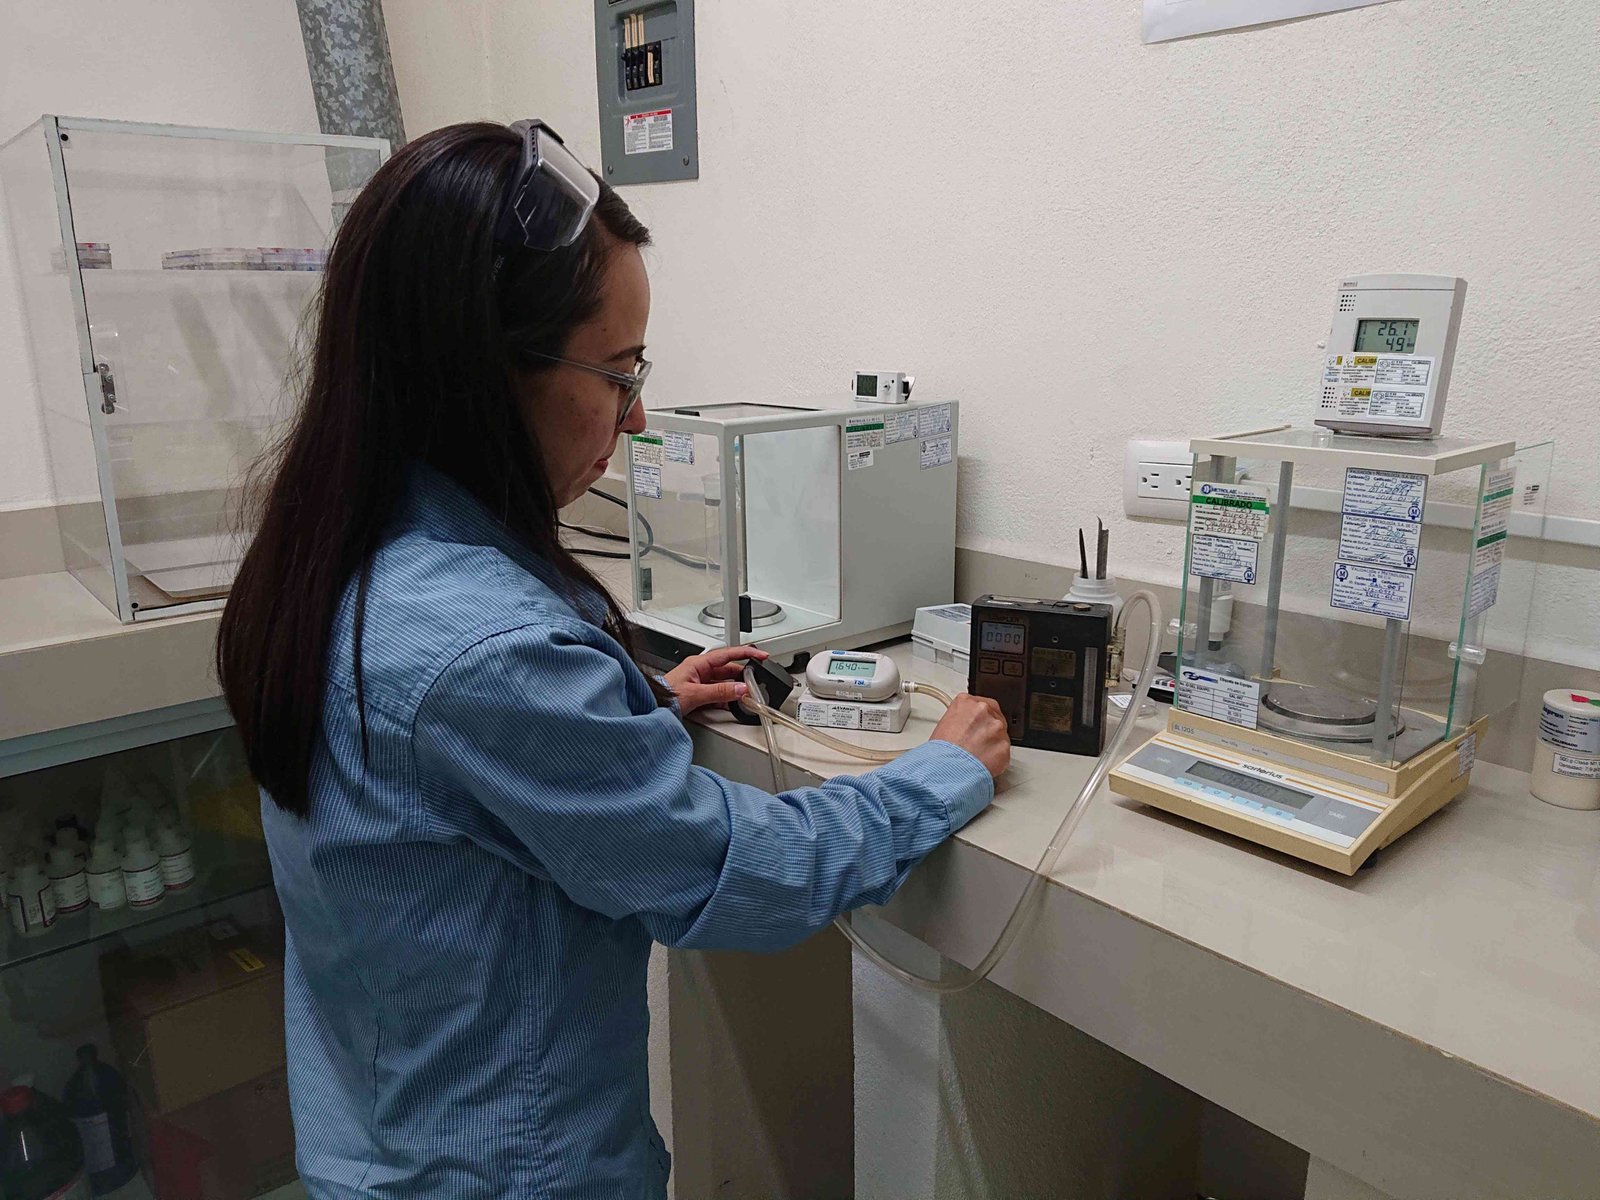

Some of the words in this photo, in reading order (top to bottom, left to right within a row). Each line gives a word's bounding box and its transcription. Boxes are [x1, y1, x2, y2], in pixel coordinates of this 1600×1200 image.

[1378, 321, 1408, 336] 26.1
[1386, 337, 1405, 352] 49
[1205, 497, 1253, 509] CALIBRADO
[1242, 763, 1282, 779] sartorius
